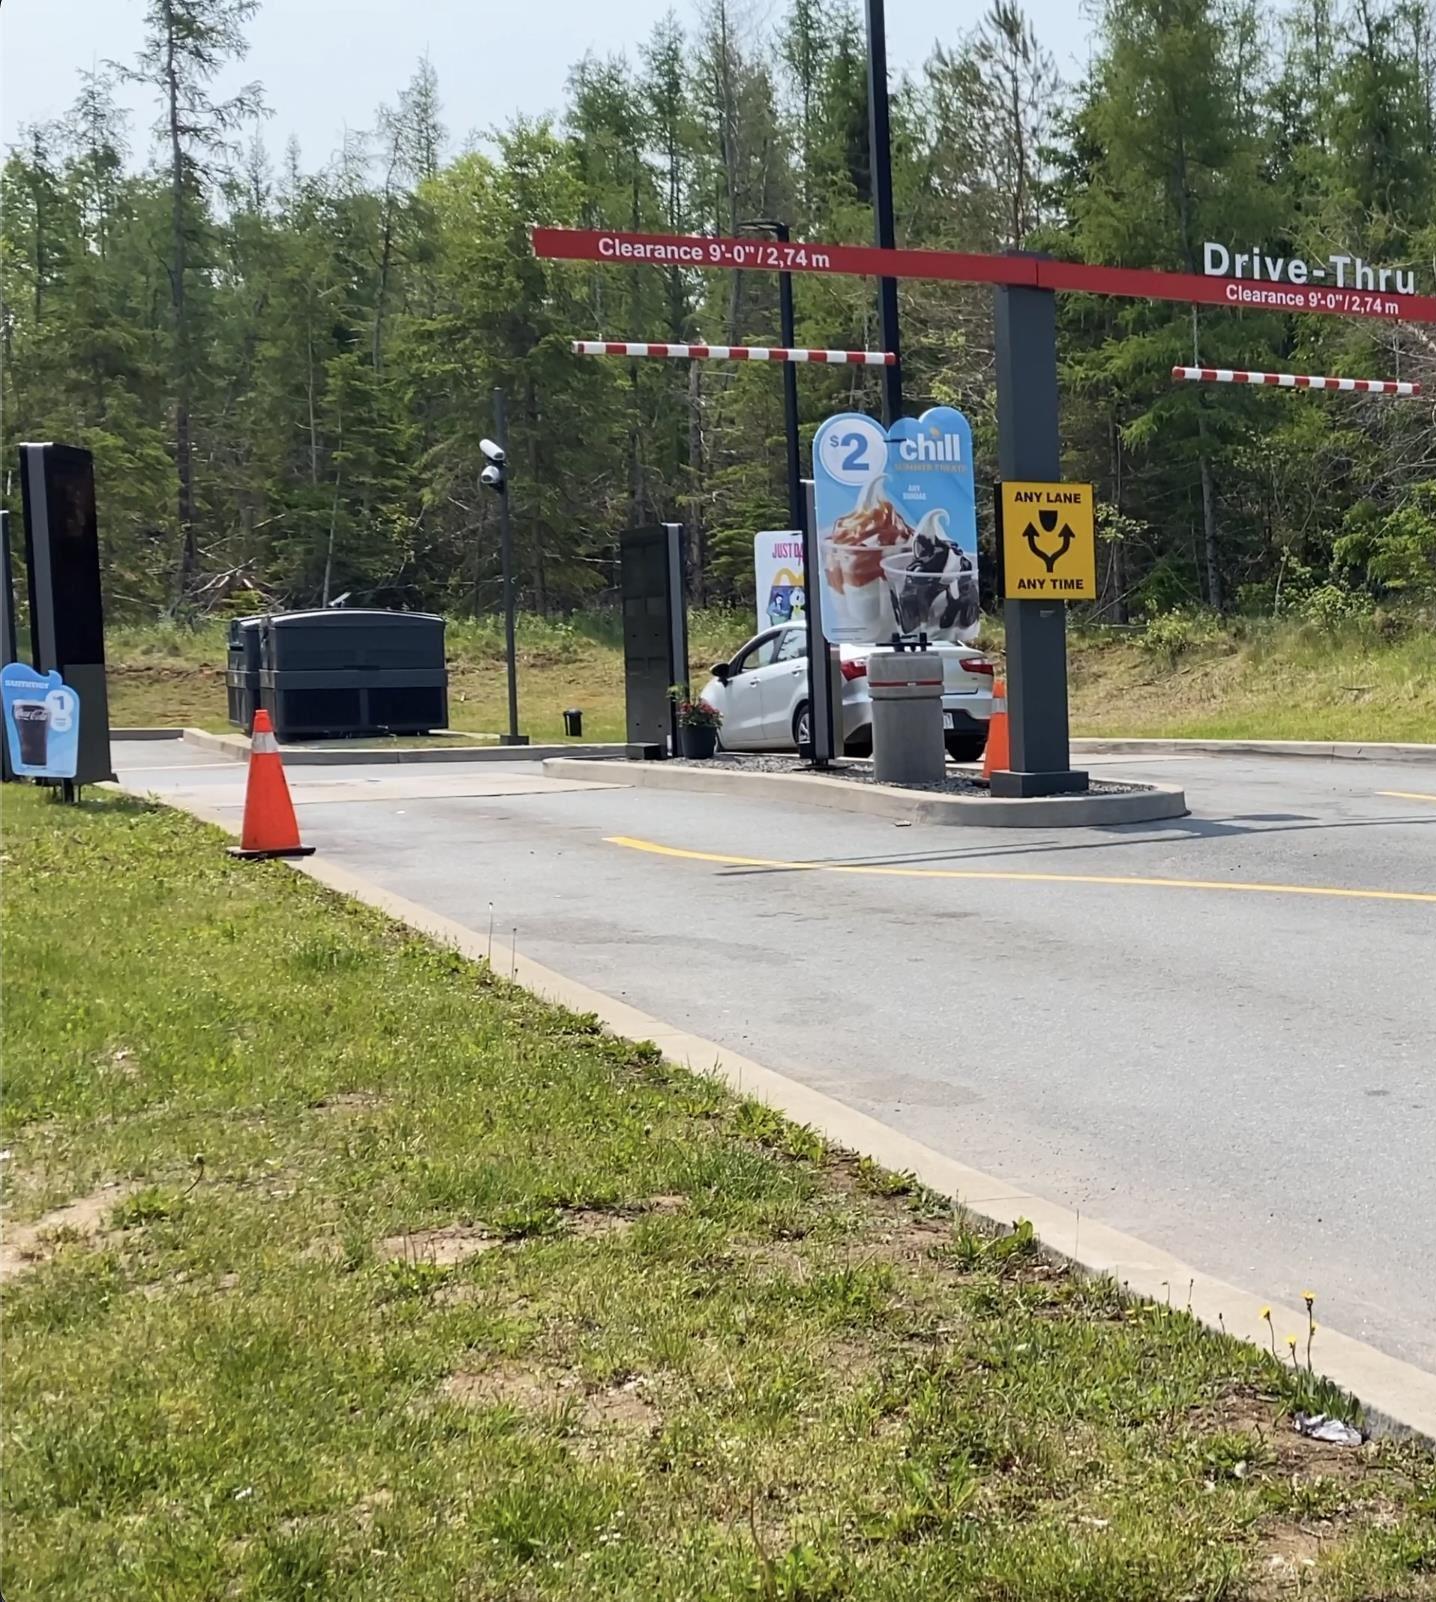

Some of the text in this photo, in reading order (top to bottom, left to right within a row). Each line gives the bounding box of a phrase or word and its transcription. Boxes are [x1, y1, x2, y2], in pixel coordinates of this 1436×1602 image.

[598, 237, 704, 260] Clearance
[811, 253, 830, 268] m
[1203, 241, 1415, 294] Drive-Thru
[1226, 284, 1304, 306] Clearance
[1385, 302, 1399, 314] m
[829, 432, 870, 471] $2
[899, 433, 961, 462] chill
[1014, 491, 1081, 504] ANY LANE
[772, 542, 792, 558] JUST
[1017, 578, 1084, 590] ANY TIME
